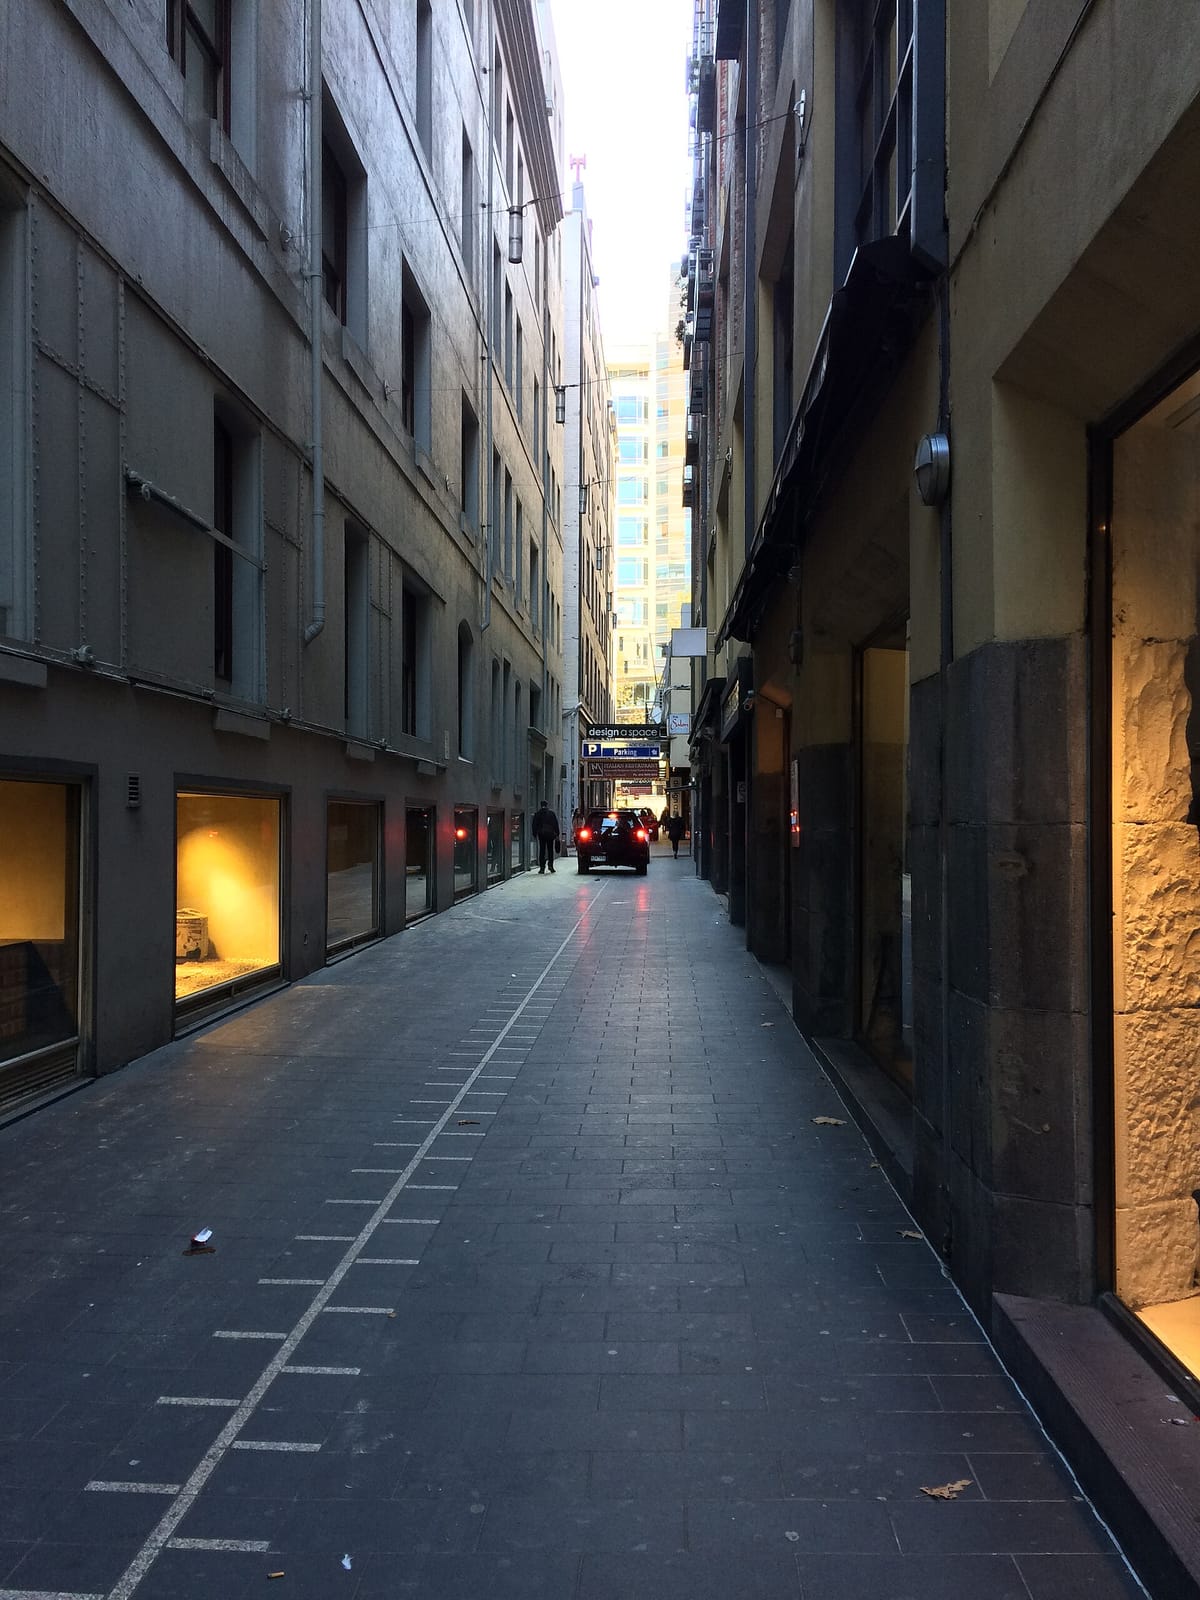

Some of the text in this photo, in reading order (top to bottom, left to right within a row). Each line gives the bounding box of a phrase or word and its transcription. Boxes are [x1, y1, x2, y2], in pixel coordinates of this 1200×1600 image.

[588, 727, 658, 738] design a space
[588, 744, 598, 756] P
[613, 748, 638, 757] Parking
